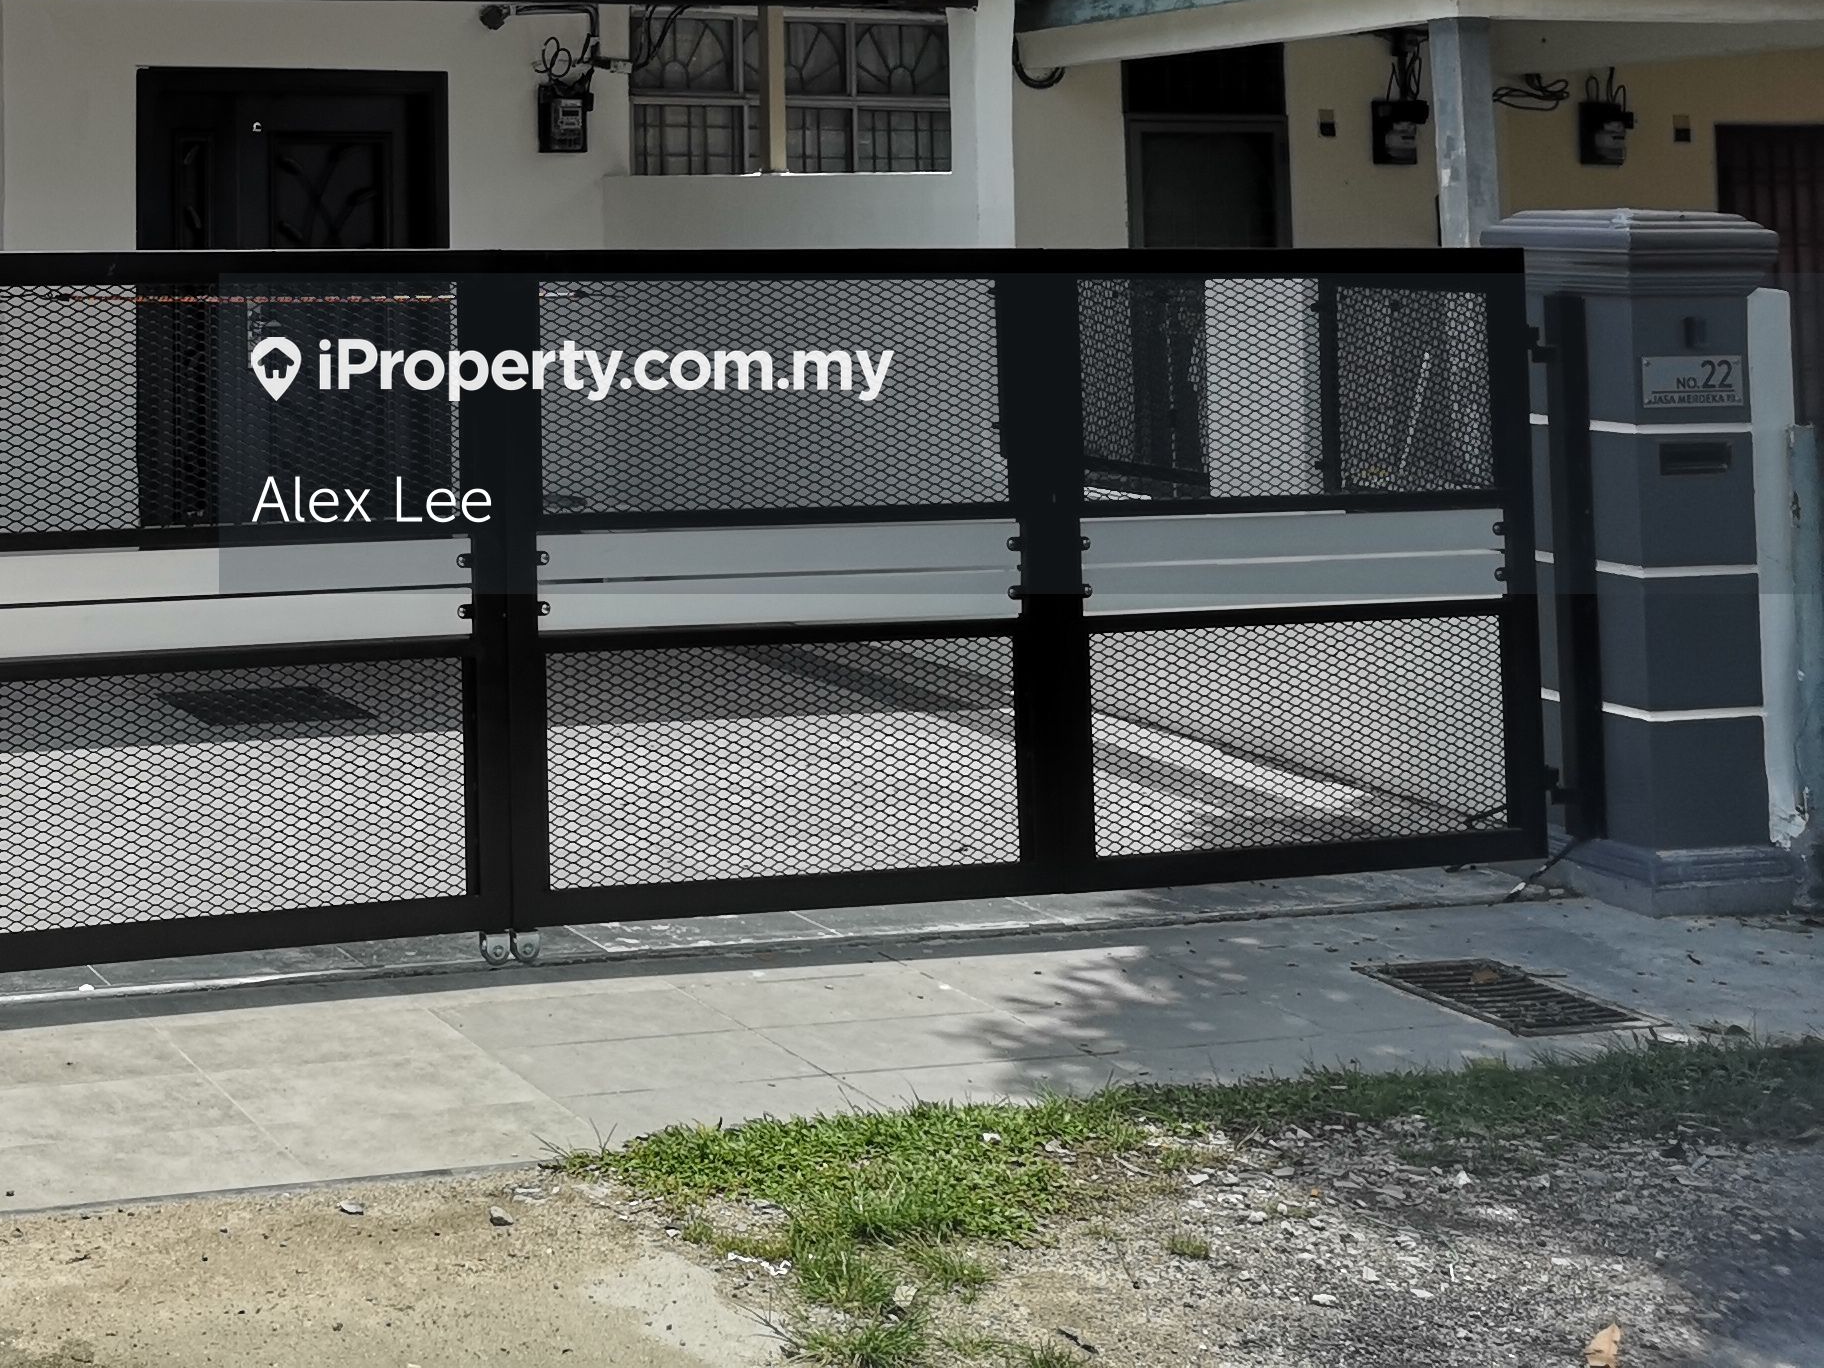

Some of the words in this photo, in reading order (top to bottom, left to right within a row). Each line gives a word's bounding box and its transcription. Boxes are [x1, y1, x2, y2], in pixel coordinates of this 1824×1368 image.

[1676, 376, 1700, 390] NO.
[1701, 360, 1733, 389] 22
[1677, 393, 1725, 404] MERDEKA
